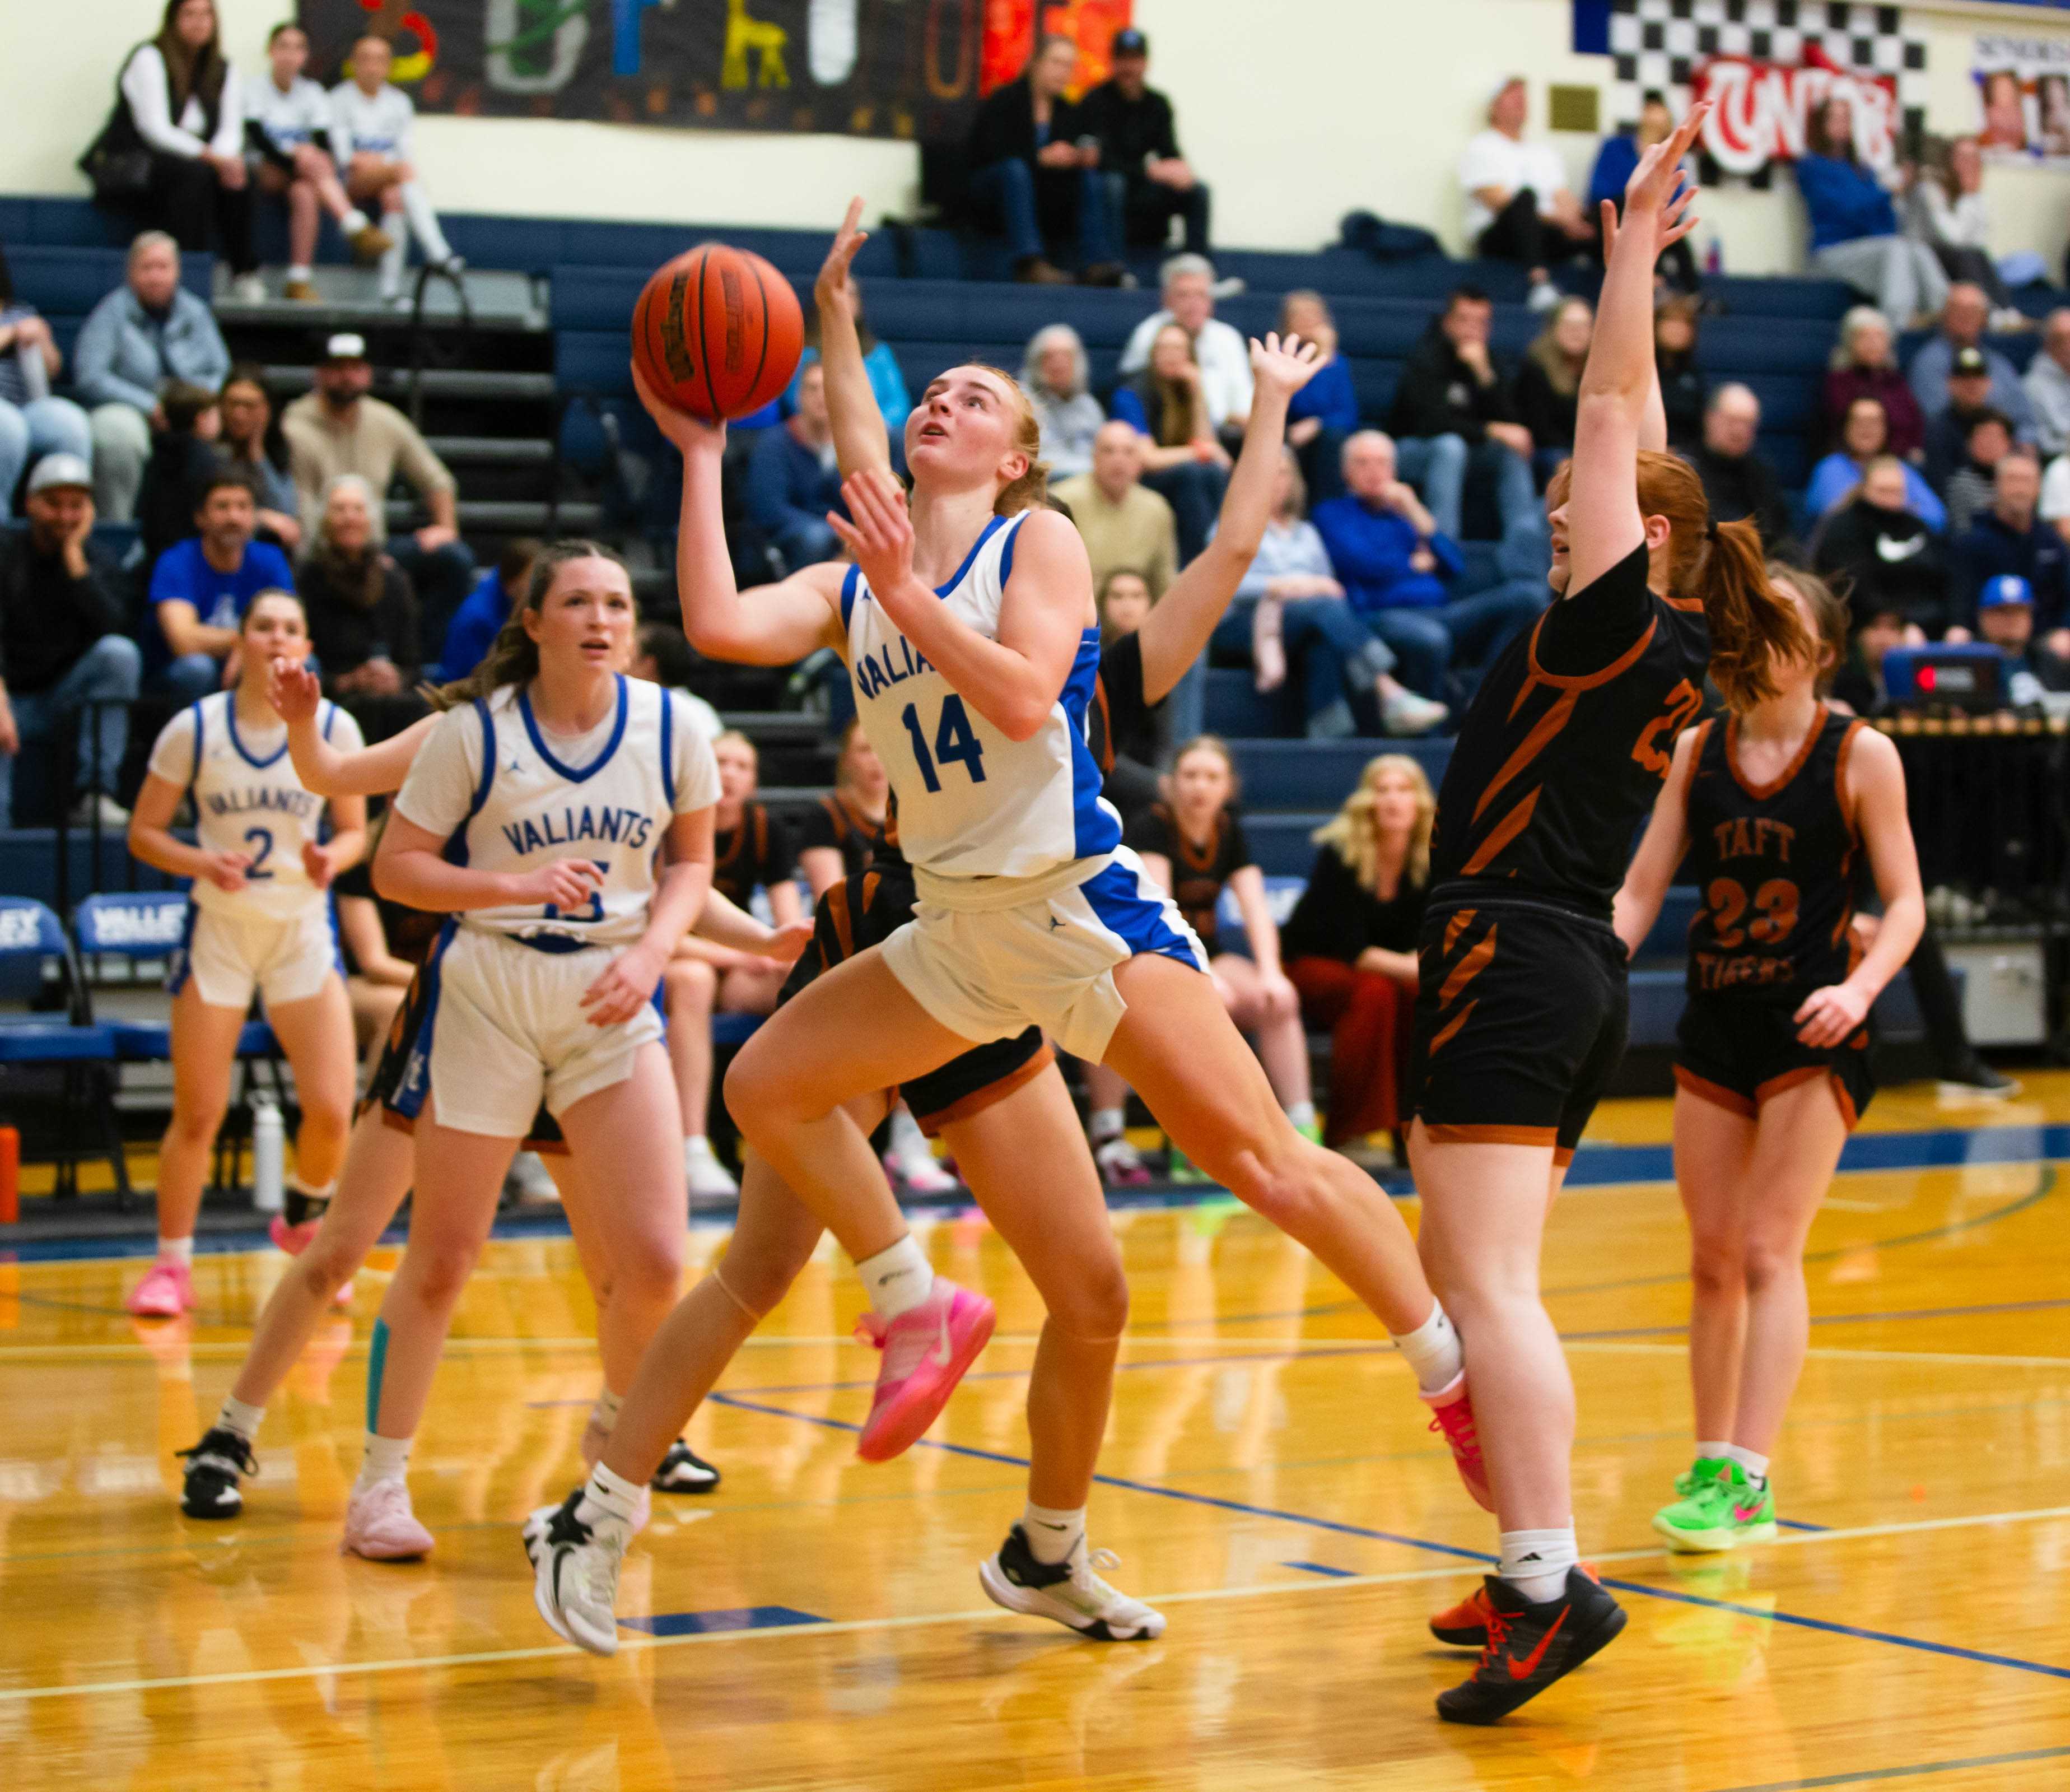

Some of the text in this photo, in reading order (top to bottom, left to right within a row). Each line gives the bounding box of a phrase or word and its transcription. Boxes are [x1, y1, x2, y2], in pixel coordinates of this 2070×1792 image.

[856, 635, 936, 700] VALIA
[901, 693, 986, 793] 14
[207, 787, 314, 817] VALIANTS
[244, 827, 274, 879] 2
[502, 806, 654, 855] VALIANTS
[1714, 817, 1796, 861] TAFT
[1708, 878, 1799, 948] 23
